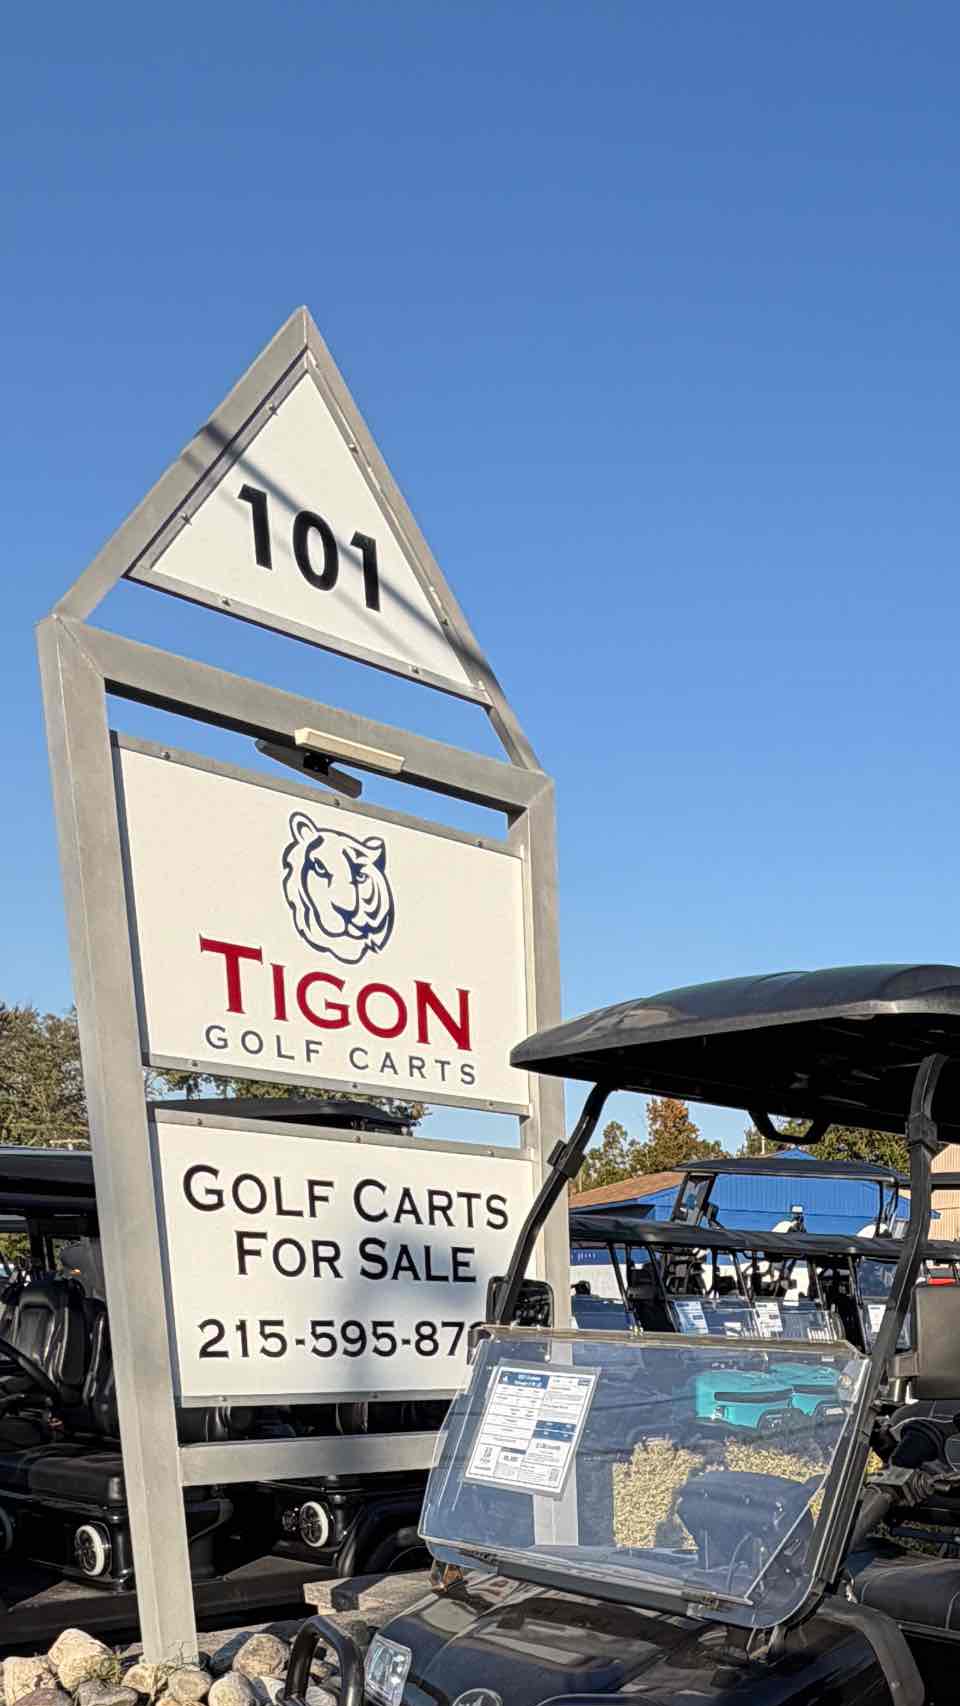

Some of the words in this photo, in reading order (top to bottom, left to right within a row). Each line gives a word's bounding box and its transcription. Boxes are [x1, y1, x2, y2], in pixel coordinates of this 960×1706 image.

[238, 484, 381, 612] 101
[199, 934, 473, 1052] TIGON
[204, 1024, 324, 1064] GOLF
[348, 1046, 477, 1086] CARTS
[182, 1163, 335, 1219] GOLF
[353, 1177, 509, 1231] CARTS
[235, 1230, 344, 1280] FOR
[358, 1236, 478, 1284] SALE
[197, 1318, 484, 1358] 215-595-87
